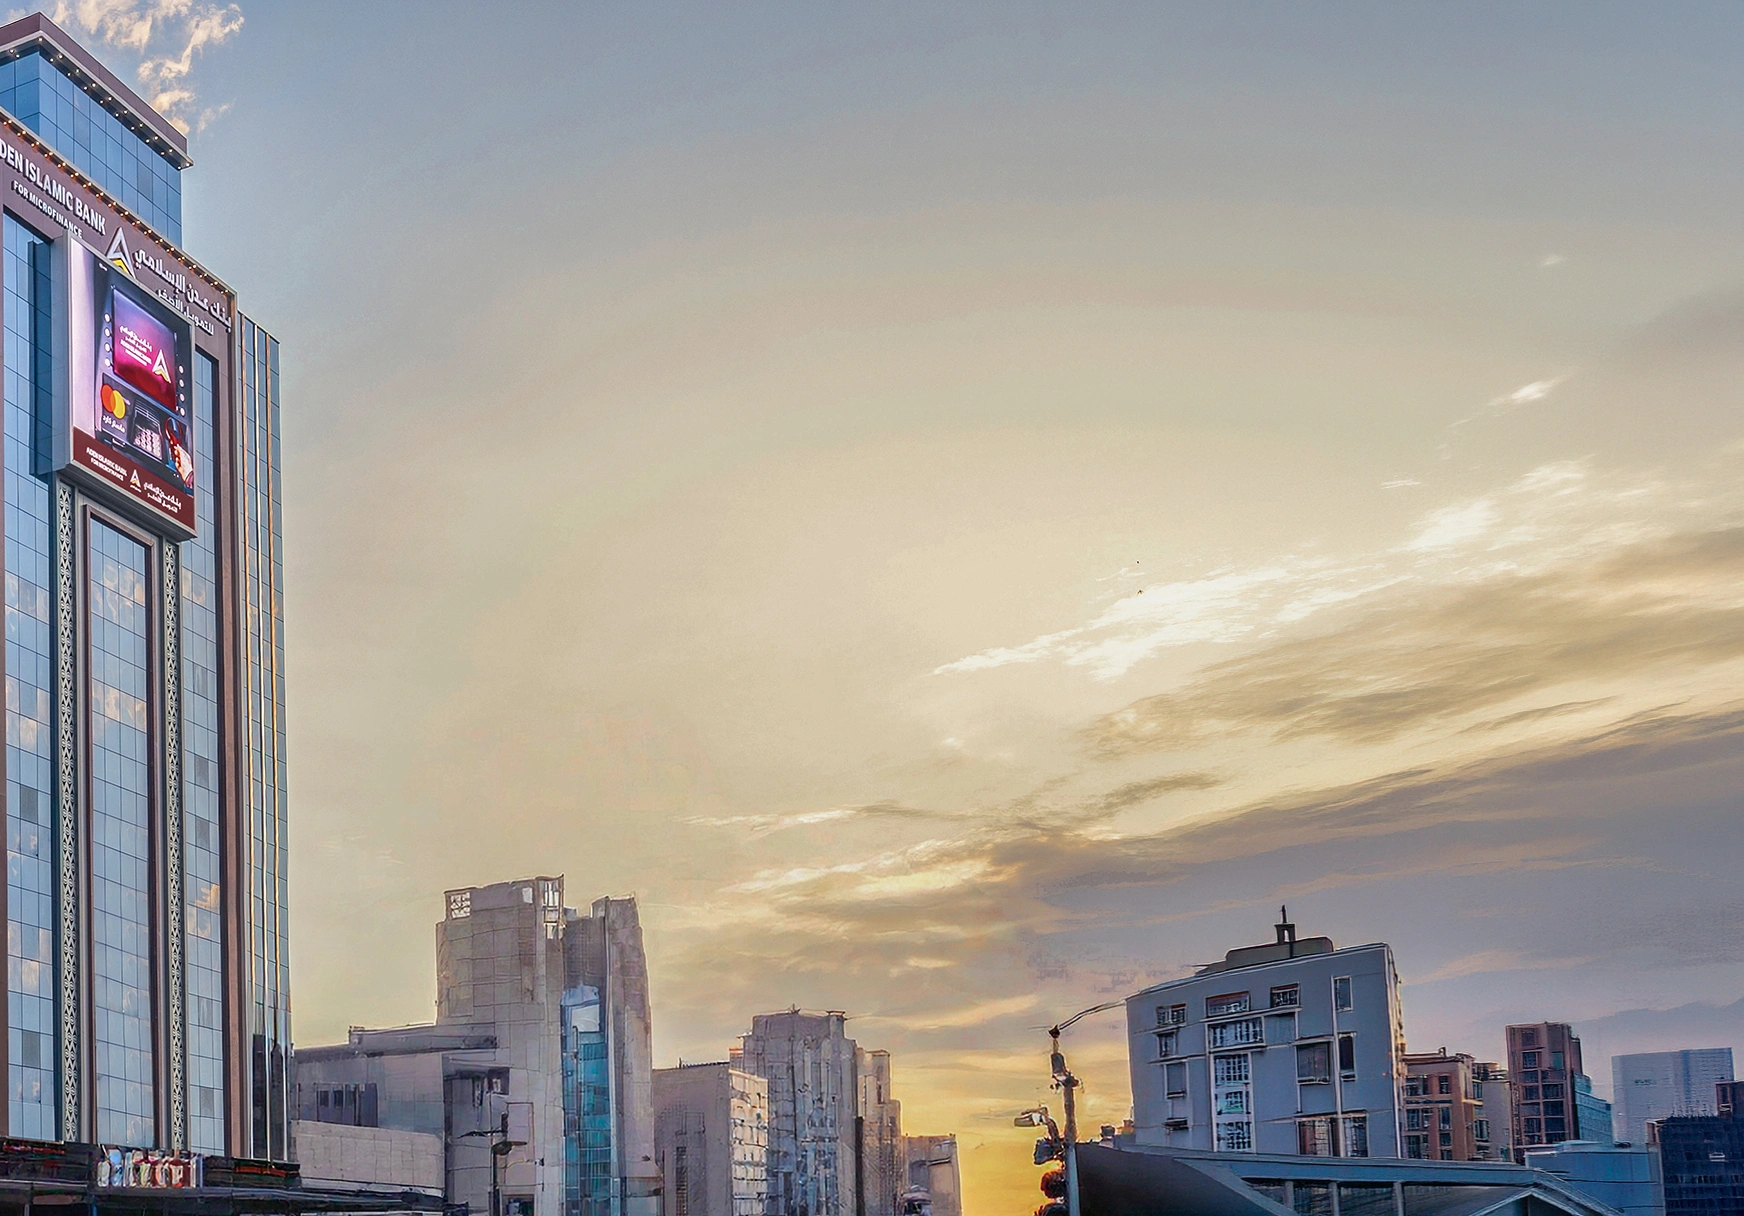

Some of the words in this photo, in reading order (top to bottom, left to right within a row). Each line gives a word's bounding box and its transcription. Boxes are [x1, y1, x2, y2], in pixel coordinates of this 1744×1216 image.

[13, 180, 29, 198] FOR
[29, 192, 83, 239] MICROFINANCE
[25, 158, 74, 212] ISLAMIC
[75, 197, 106, 236] BANK
[135, 249, 186, 294] الإسلامي
[187, 283, 209, 311] عدن
[209, 302, 231, 333] بنك
